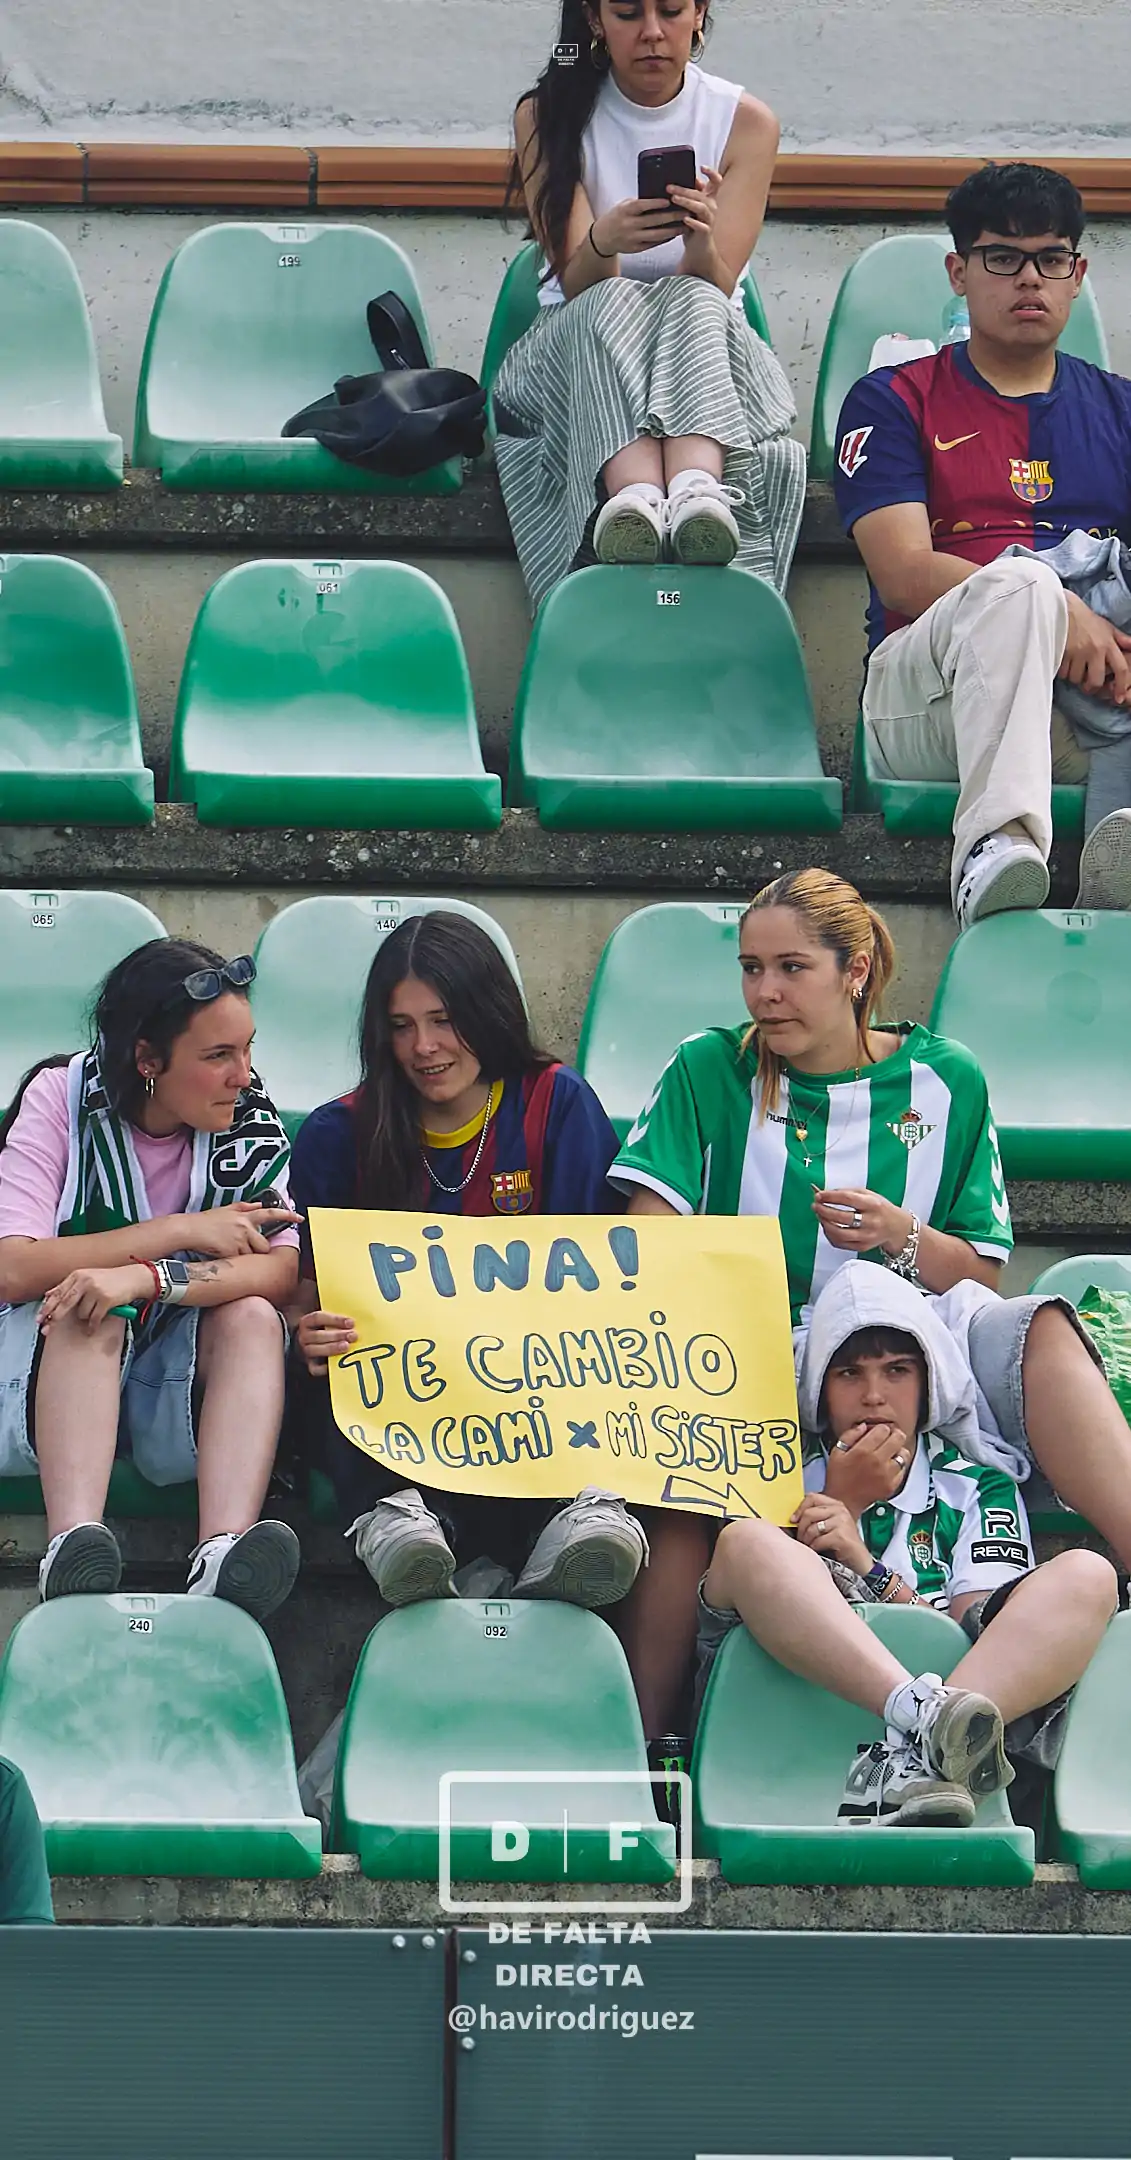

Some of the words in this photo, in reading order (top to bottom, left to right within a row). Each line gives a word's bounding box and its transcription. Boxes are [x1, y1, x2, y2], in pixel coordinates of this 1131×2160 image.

[319, 582, 338, 593] 061
[660, 593, 680, 604] 156
[32, 914, 53, 925] 065
[376, 919, 397, 930] 140
[338, 1338, 447, 1409] TE
[348, 1422, 426, 1465] LA
[984, 1507, 1020, 1538] R
[972, 1545, 1028, 1563] REVEL
[129, 1619, 150, 1632] 240
[485, 1625, 506, 1637] 092
